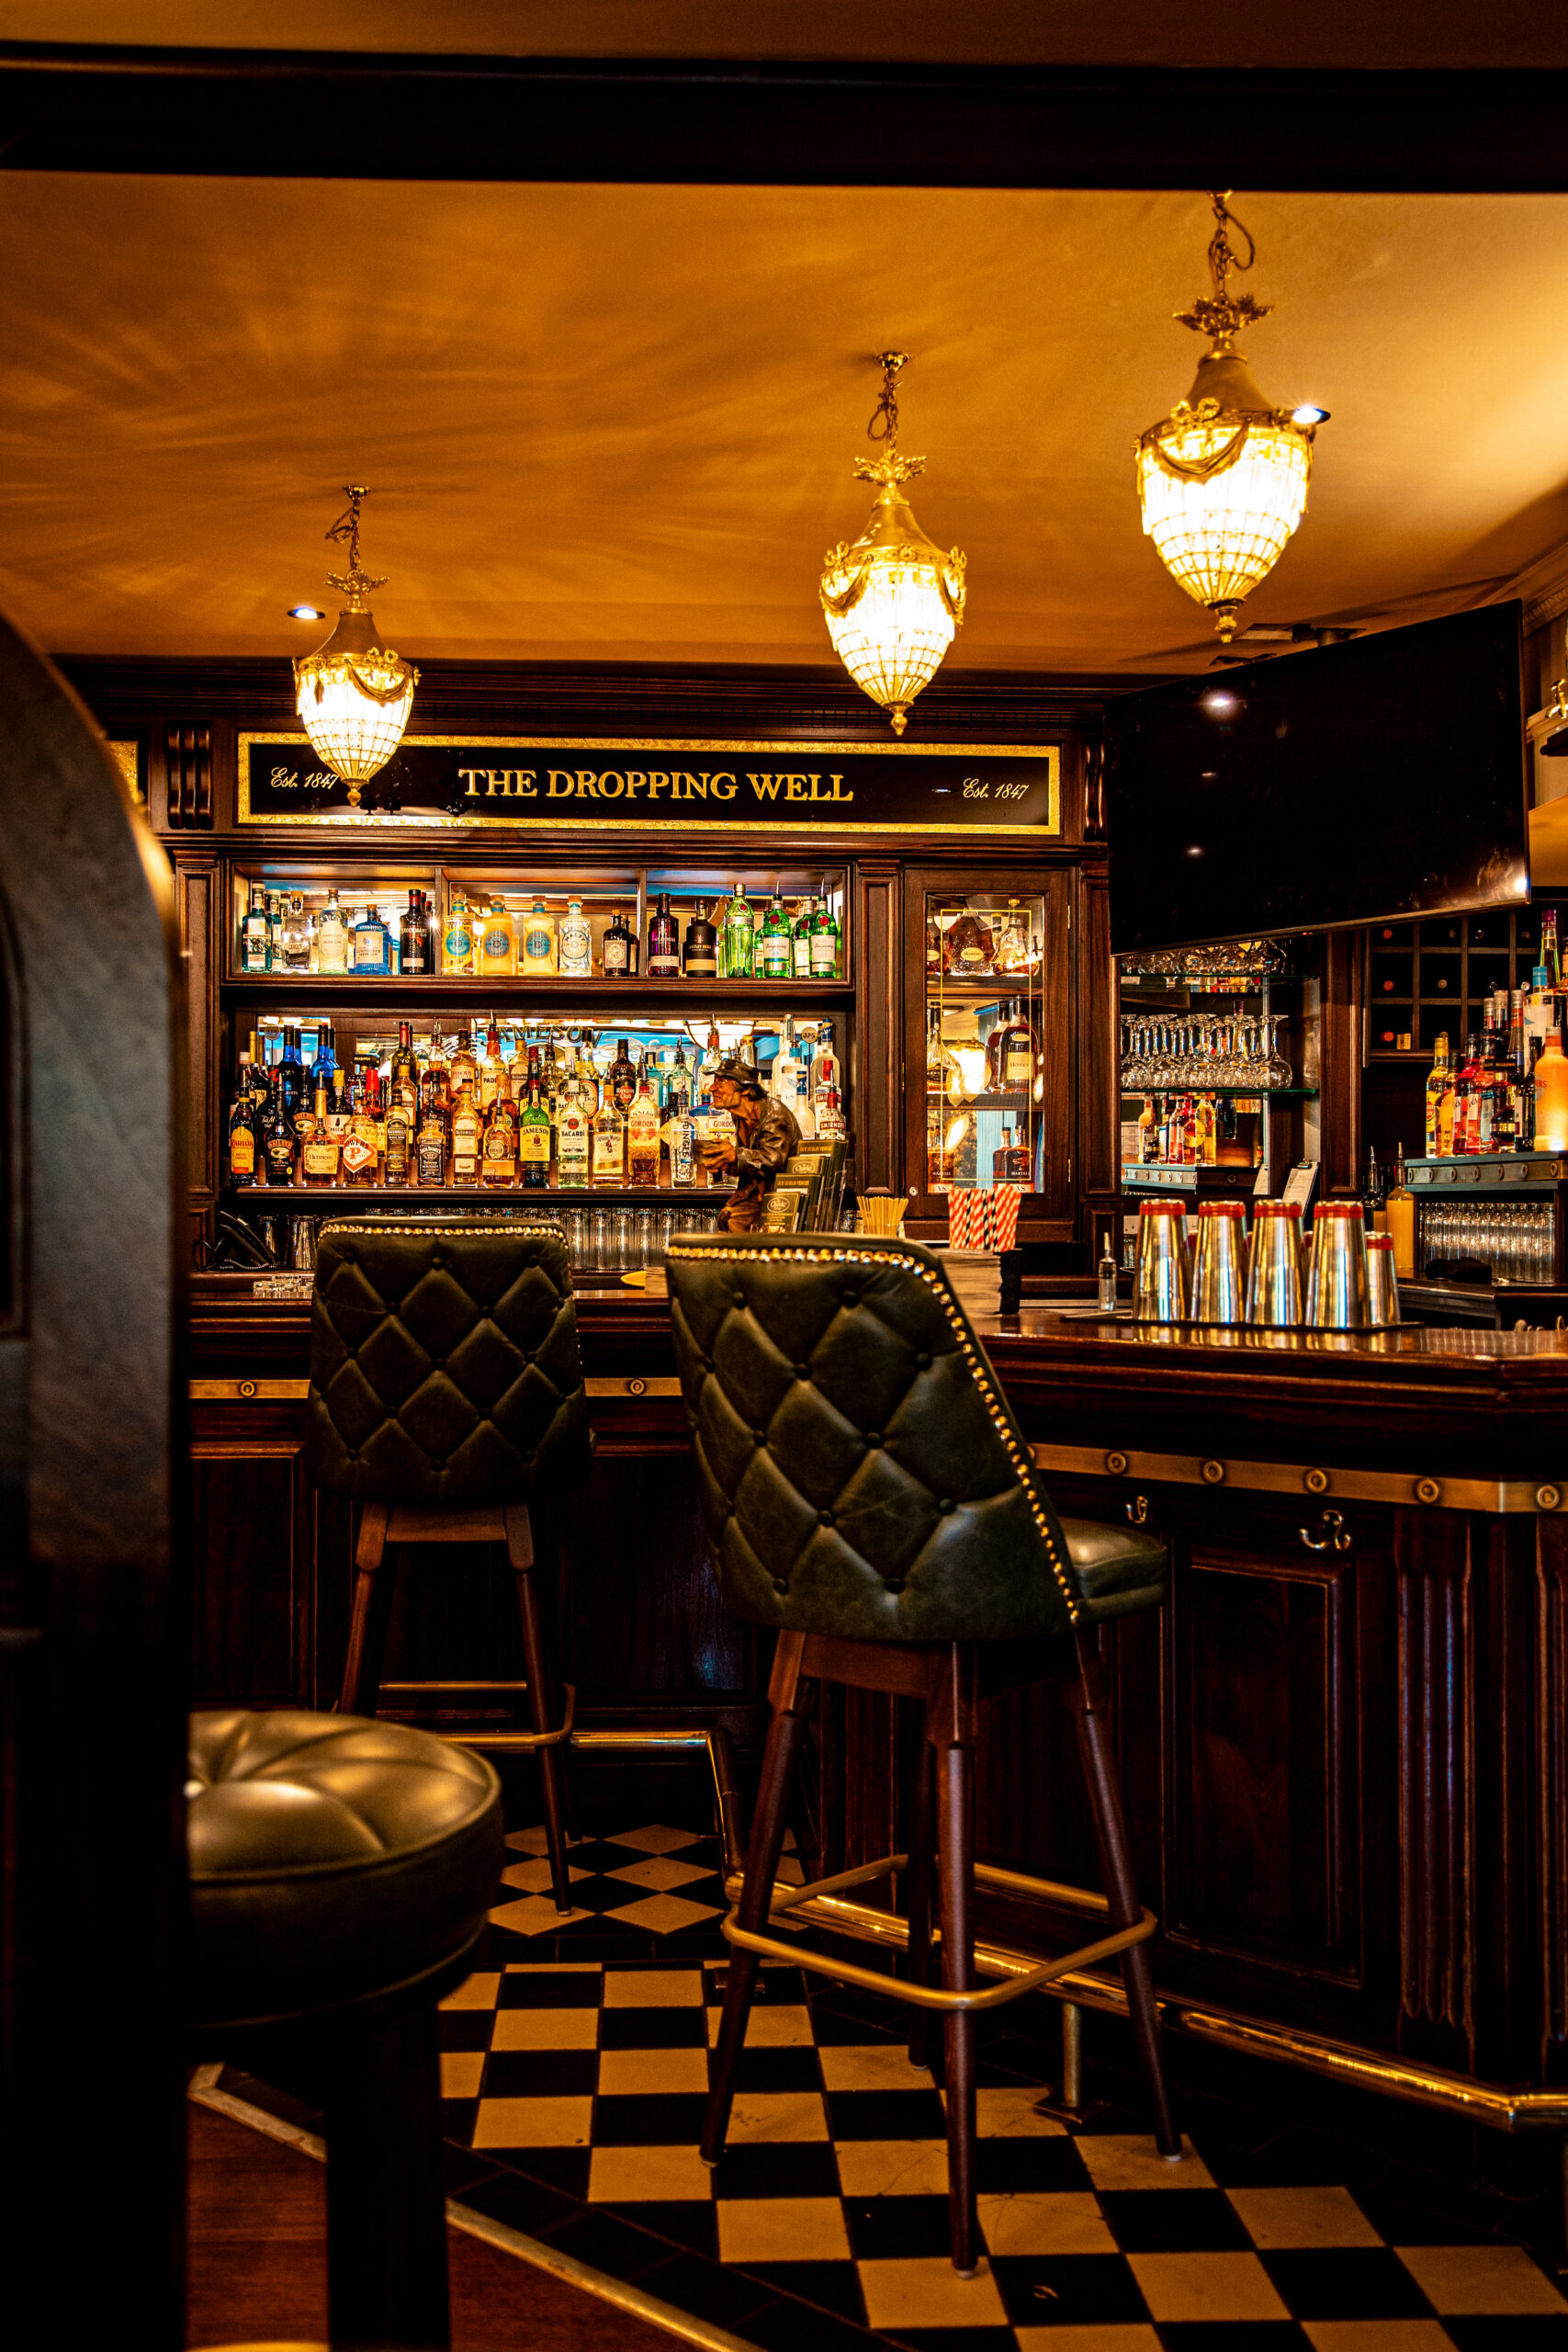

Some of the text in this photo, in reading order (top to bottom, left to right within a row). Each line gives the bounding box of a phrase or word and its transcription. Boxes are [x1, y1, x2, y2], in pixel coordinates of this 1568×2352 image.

[269, 766, 340, 790] Est. 1847
[457, 769, 854, 801] THE DROPPING WELL
[962, 777, 1030, 800] Est. 1847
[497, 1023, 604, 1048] AMESON
[522, 1127, 548, 1136] JAMESON
[351, 1148, 361, 1159] P
